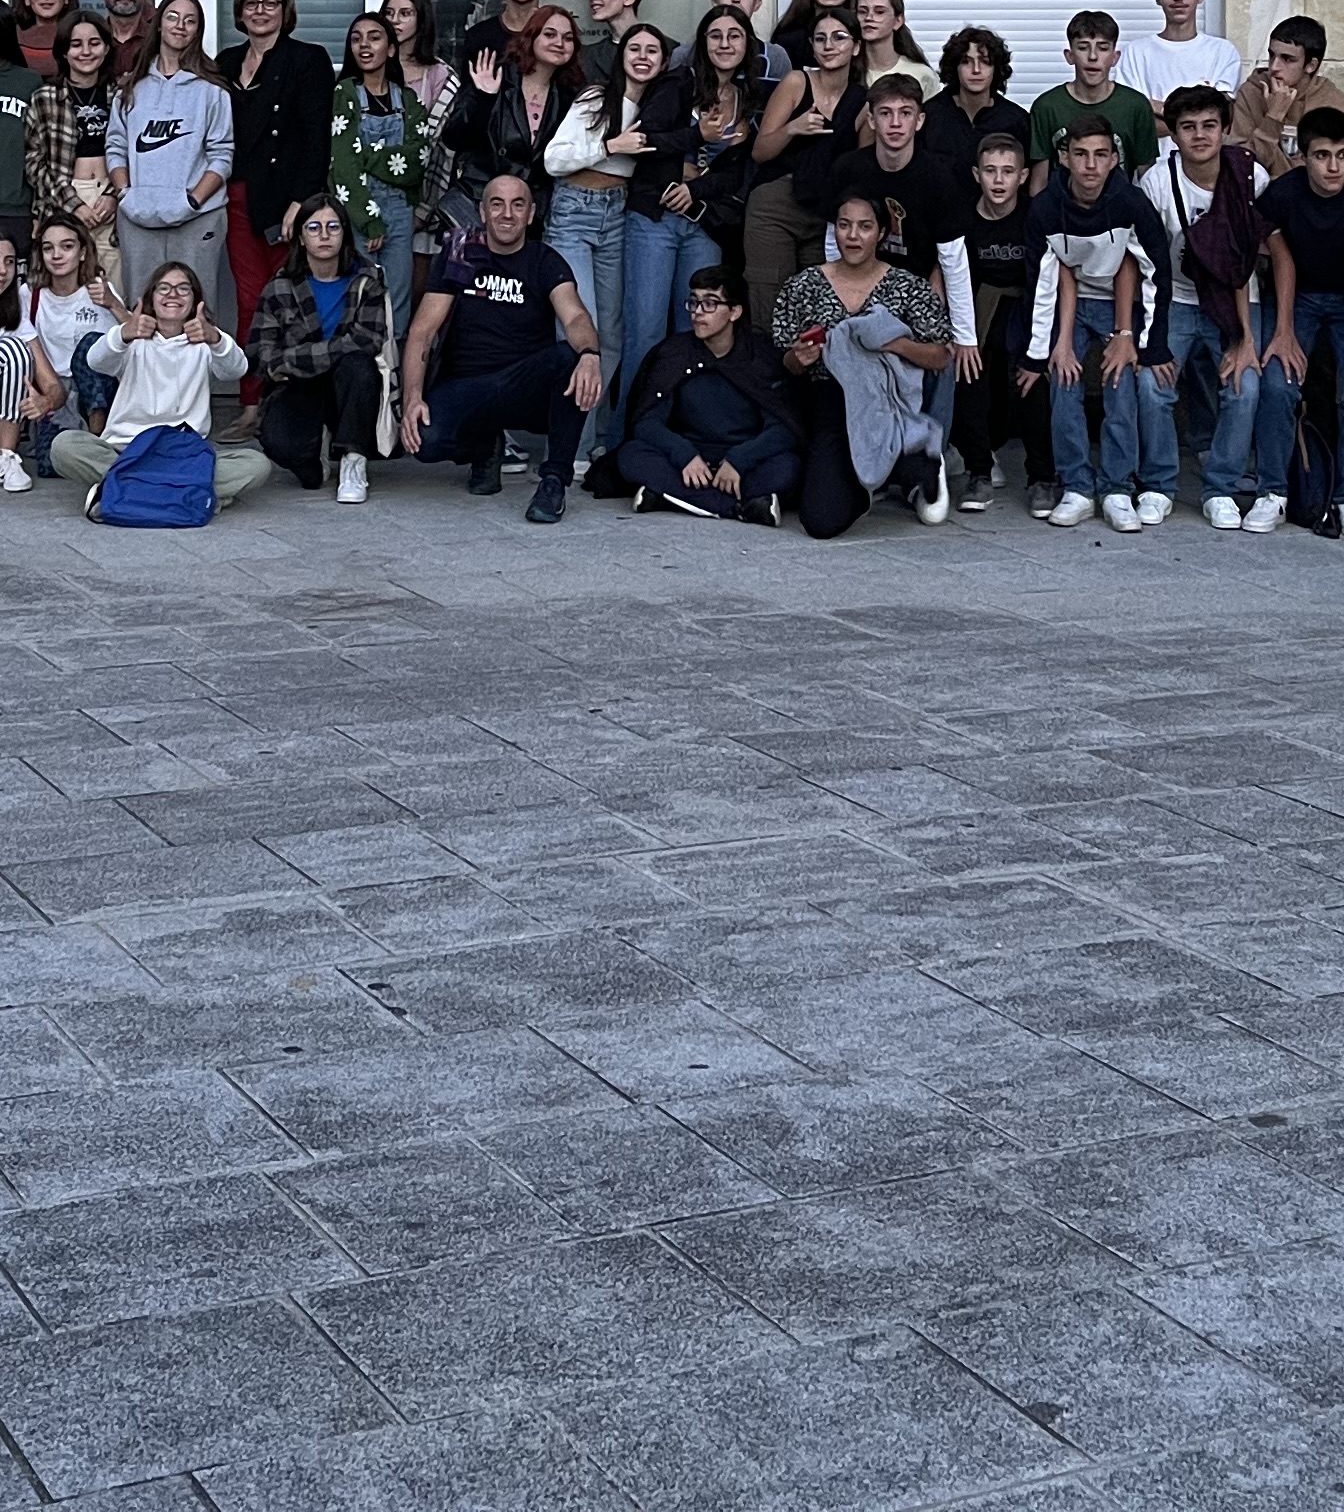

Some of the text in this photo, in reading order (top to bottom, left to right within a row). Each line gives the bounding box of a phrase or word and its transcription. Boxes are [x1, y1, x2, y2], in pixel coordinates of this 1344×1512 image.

[142, 118, 185, 139] NIKE
[474, 274, 523, 295] OMMY
[488, 290, 525, 304] JEANS
